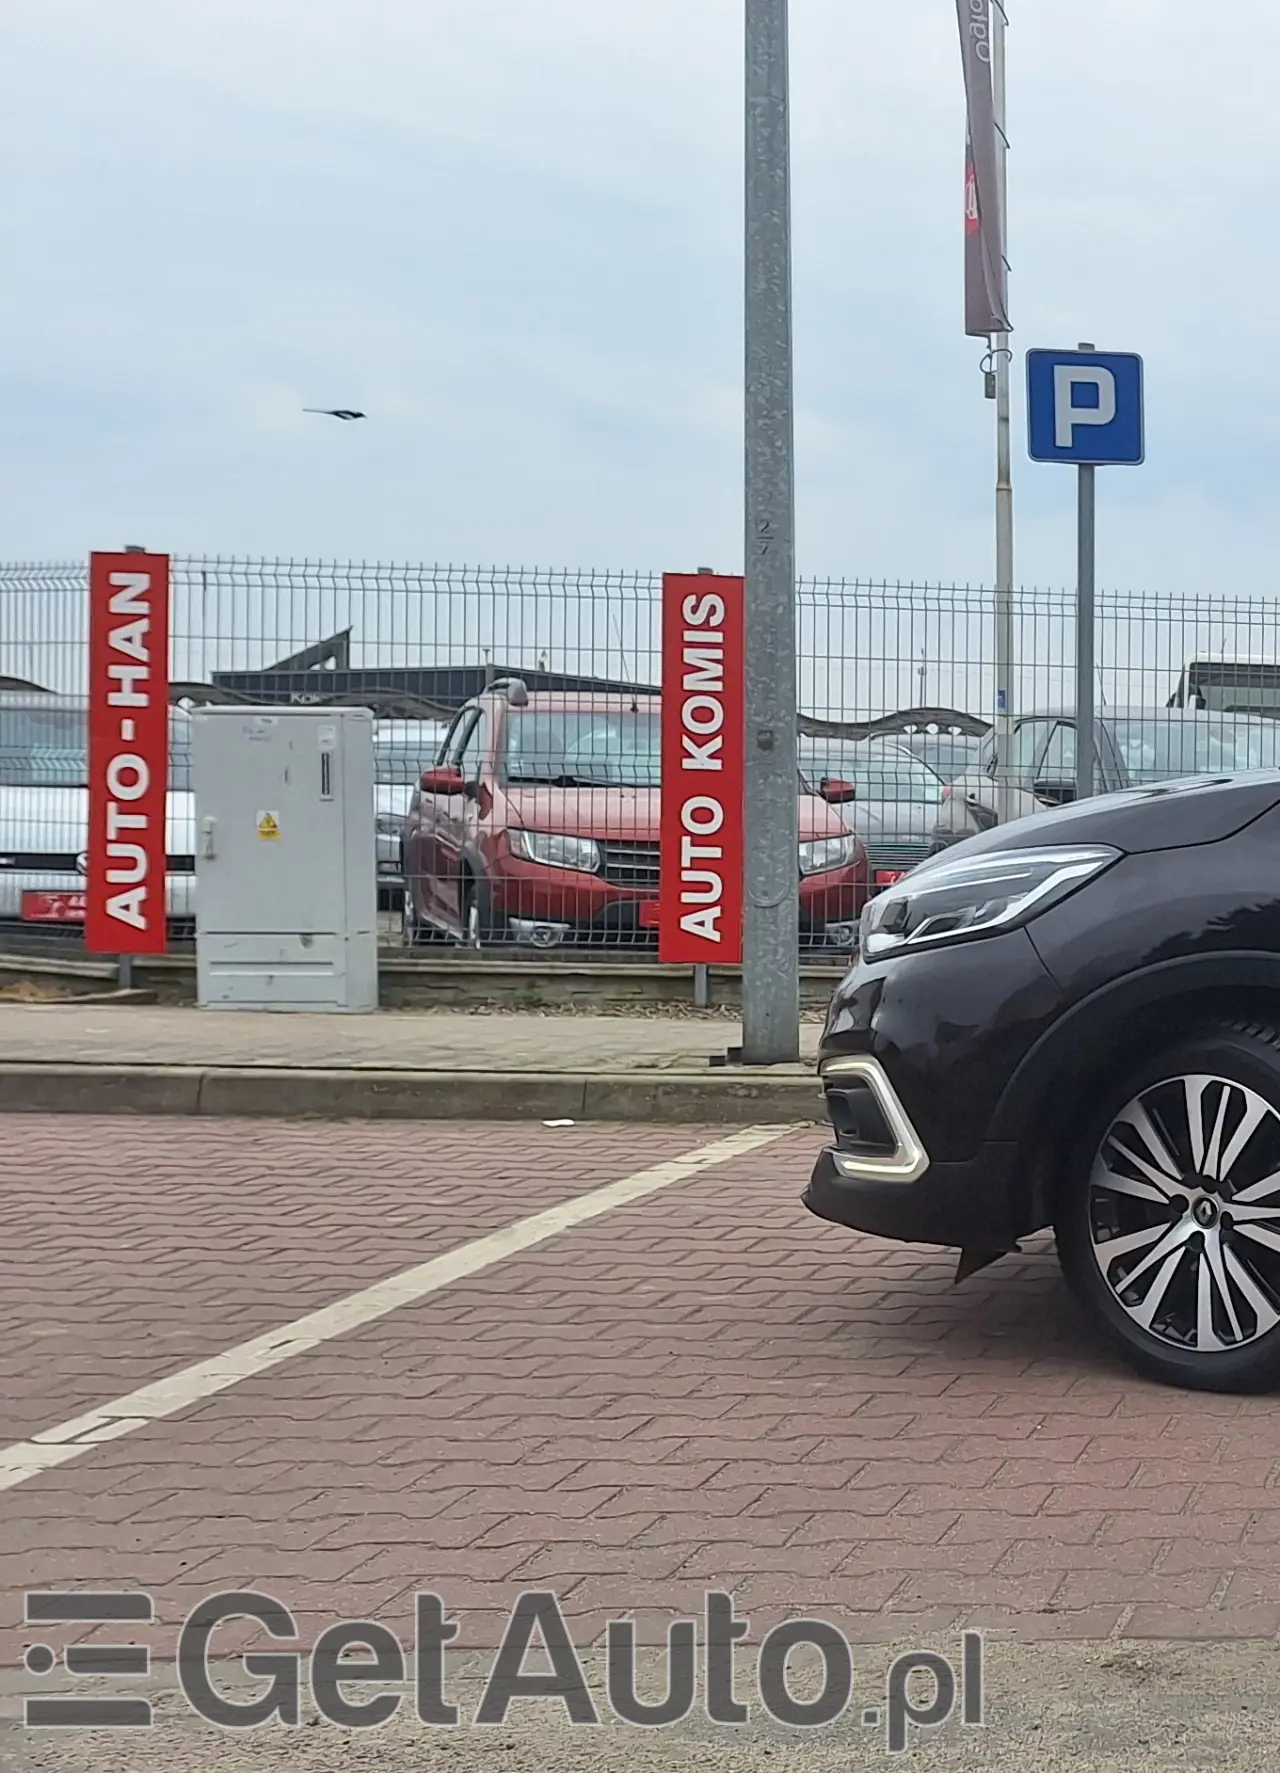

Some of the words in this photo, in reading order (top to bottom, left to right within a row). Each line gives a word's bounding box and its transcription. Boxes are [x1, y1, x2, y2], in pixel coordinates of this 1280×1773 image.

[1054, 365, 1116, 448] P
[681, 593, 725, 771] KOMIS
[680, 796, 724, 942] AUTO
